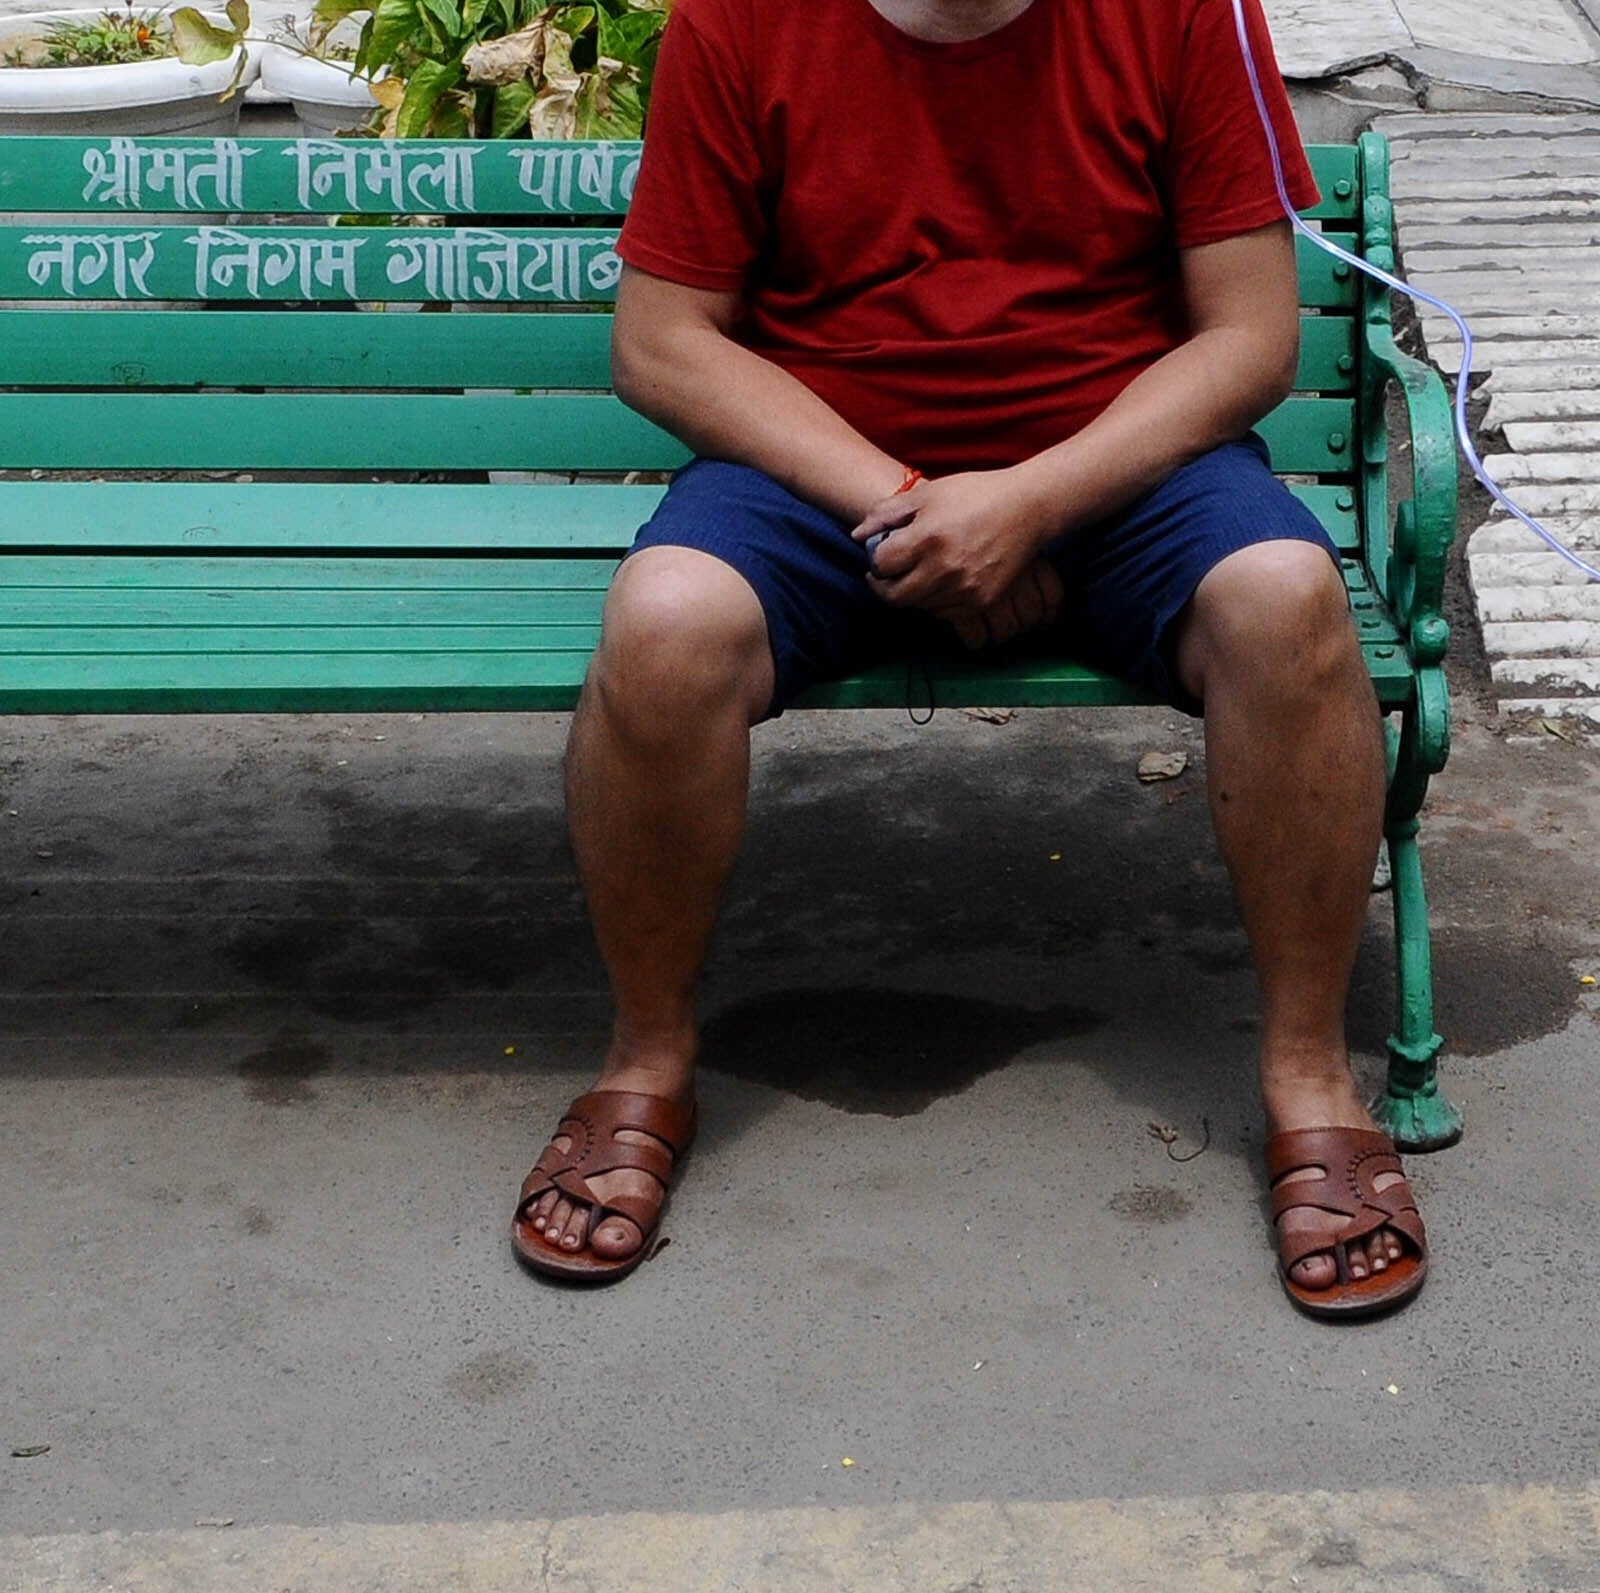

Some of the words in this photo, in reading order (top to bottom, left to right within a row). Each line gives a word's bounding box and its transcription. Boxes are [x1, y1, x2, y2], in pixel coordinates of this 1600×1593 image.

[82, 136, 262, 209] श्रीमती
[281, 138, 487, 212] निर्मला
[20, 231, 163, 299] नगर
[184, 227, 369, 301] निगम
